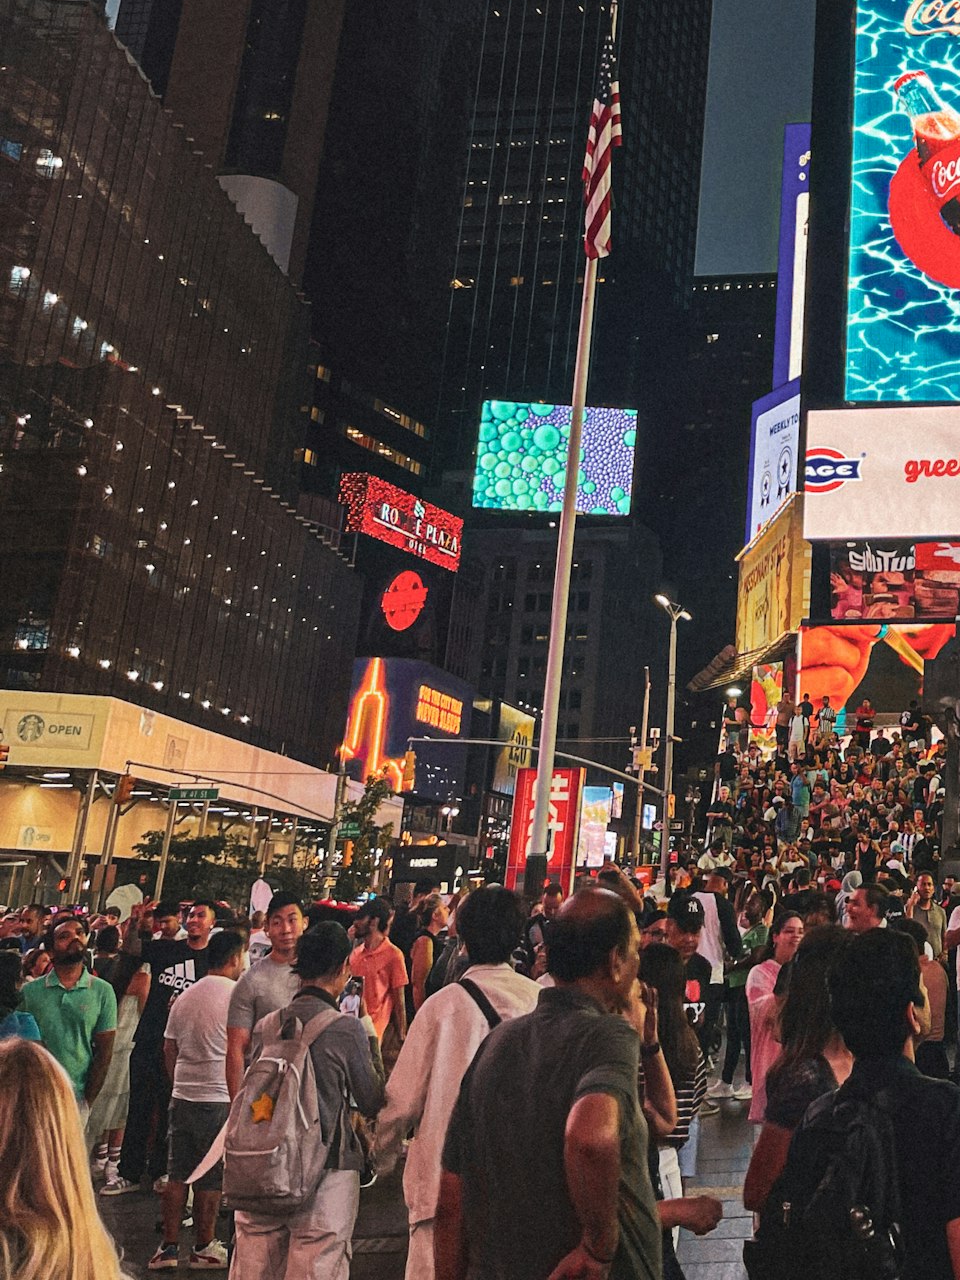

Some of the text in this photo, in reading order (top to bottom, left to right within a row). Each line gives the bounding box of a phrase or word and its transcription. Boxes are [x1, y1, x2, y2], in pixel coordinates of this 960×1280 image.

[769, 417, 791, 437] WEEKLY
[48, 724, 82, 736] OPEN
[179, 791, 188, 799] W
